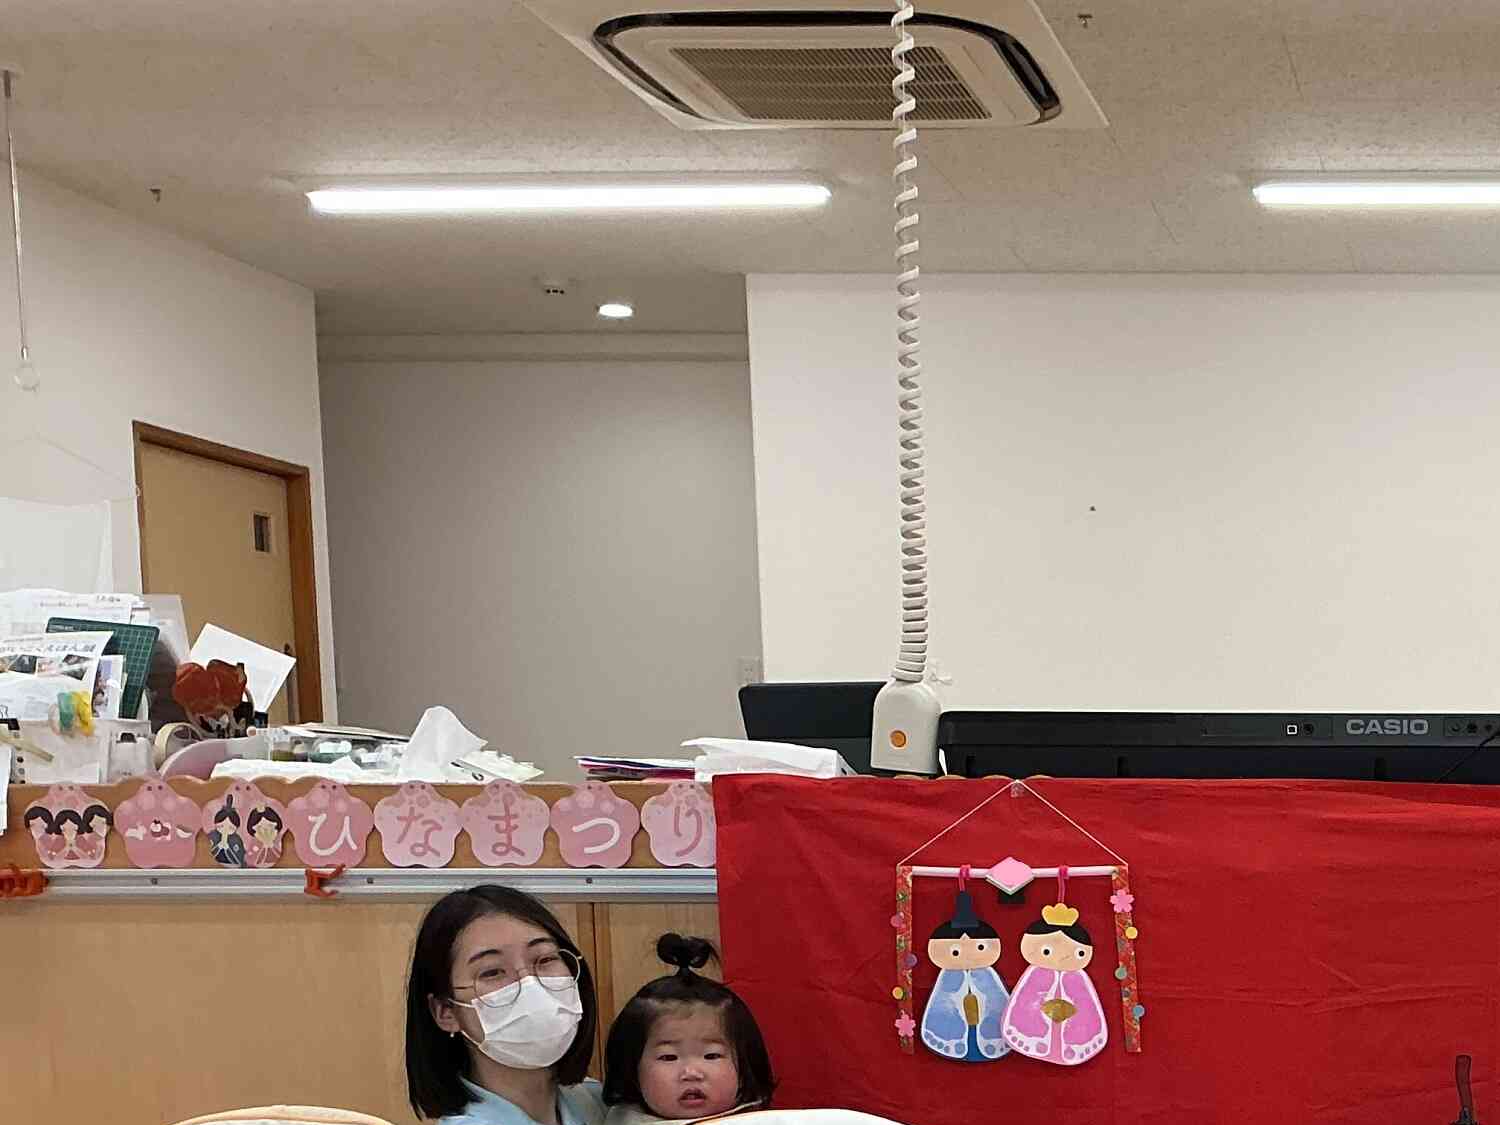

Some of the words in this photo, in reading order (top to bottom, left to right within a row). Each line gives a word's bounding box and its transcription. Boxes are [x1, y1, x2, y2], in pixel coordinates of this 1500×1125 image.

[1345, 719, 1429, 735] CASIO
[307, 803, 703, 858] ひなまつり
